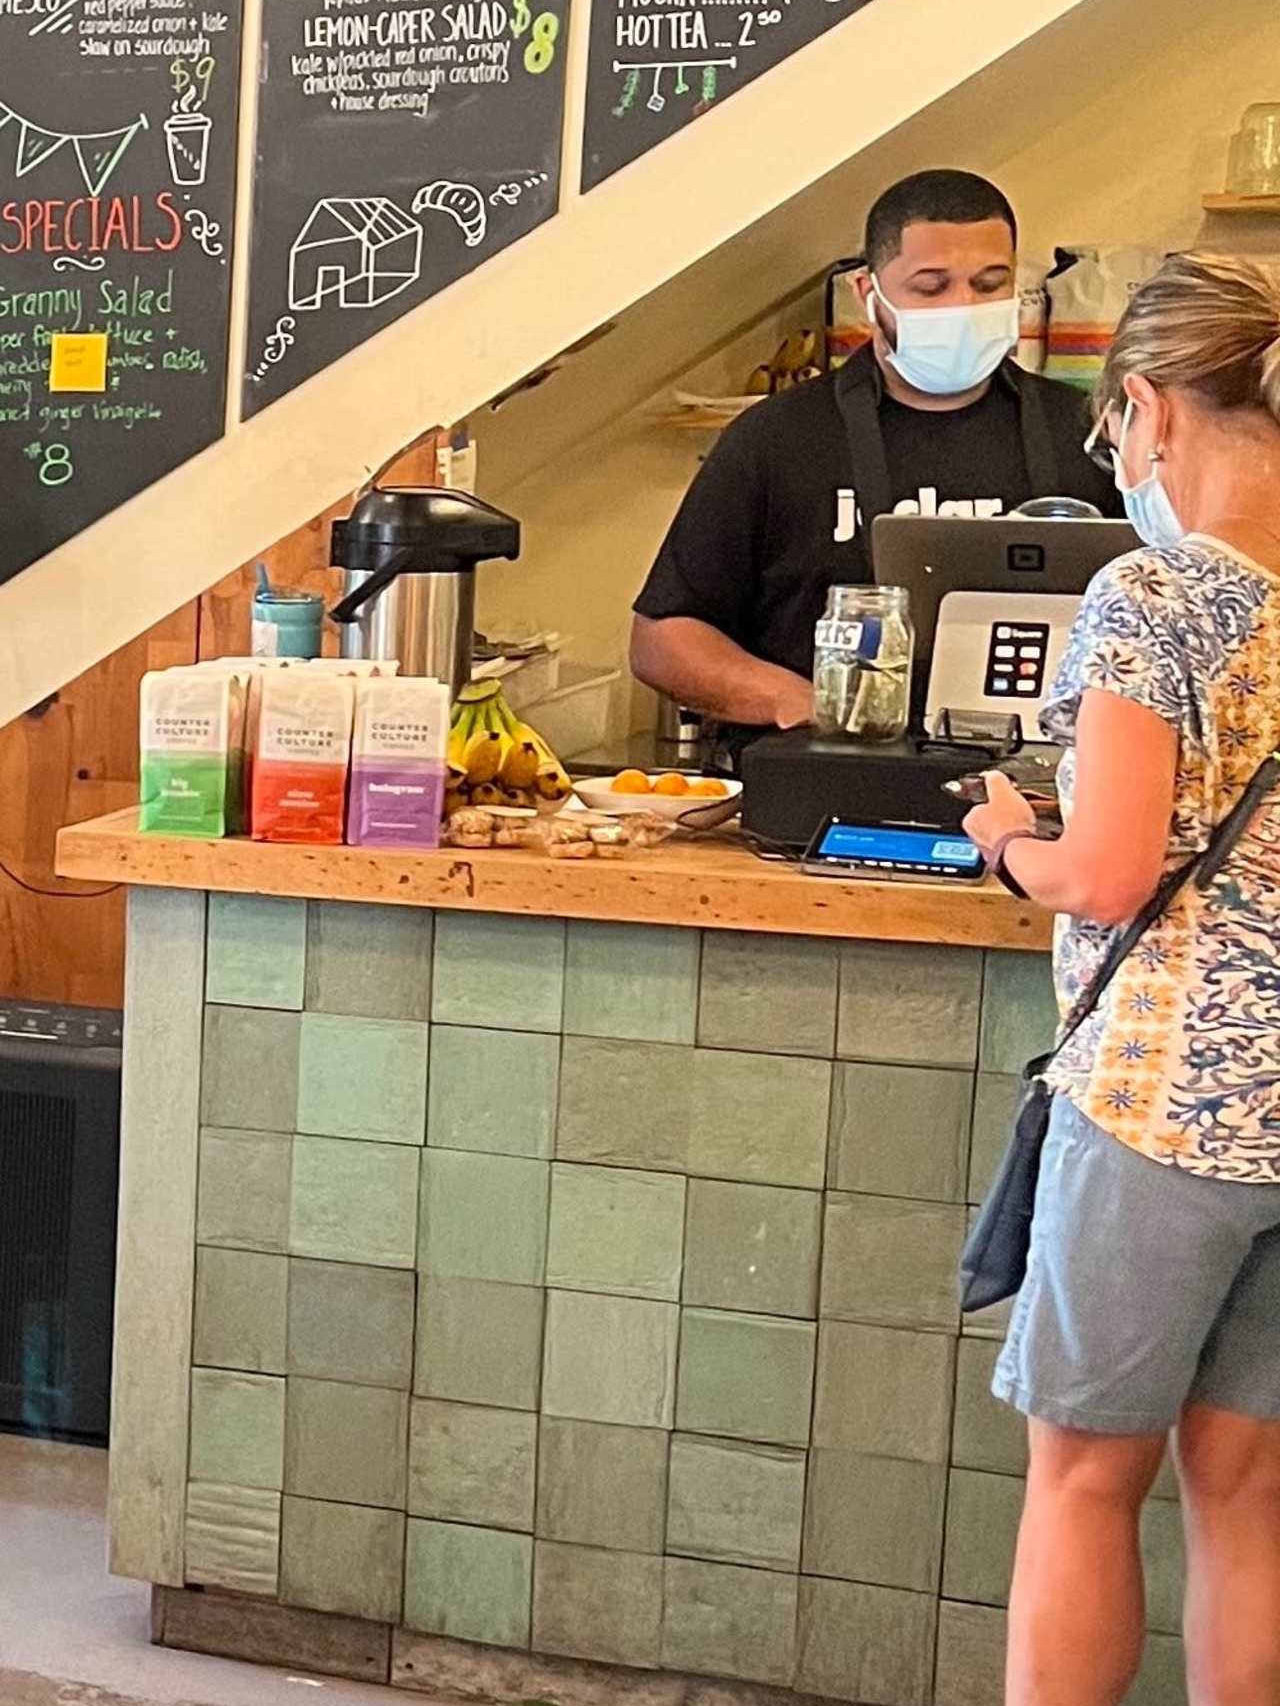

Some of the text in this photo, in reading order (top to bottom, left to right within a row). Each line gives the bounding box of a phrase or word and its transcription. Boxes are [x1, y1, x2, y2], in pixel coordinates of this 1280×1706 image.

[152, 15, 187, 33] onion
[304, 2, 507, 47] LEMON-CAPER SALAD
[617, 11, 707, 48] HOT TEA
[115, 41, 131, 55] on
[135, 34, 209, 62] sourdough
[292, 41, 510, 75] kale crispy
[170, 57, 215, 101] $9
[372, 65, 445, 93] sourdough
[379, 93, 428, 116] dressing
[1, 192, 182, 253] SPECIALS
[98, 269, 173, 315] Salad
[277, 728, 333, 737] COUNTER
[372, 723, 428, 731] COUNTER
[372, 733, 427, 741] CULTURE
[277, 738, 331, 747] CULTURE
